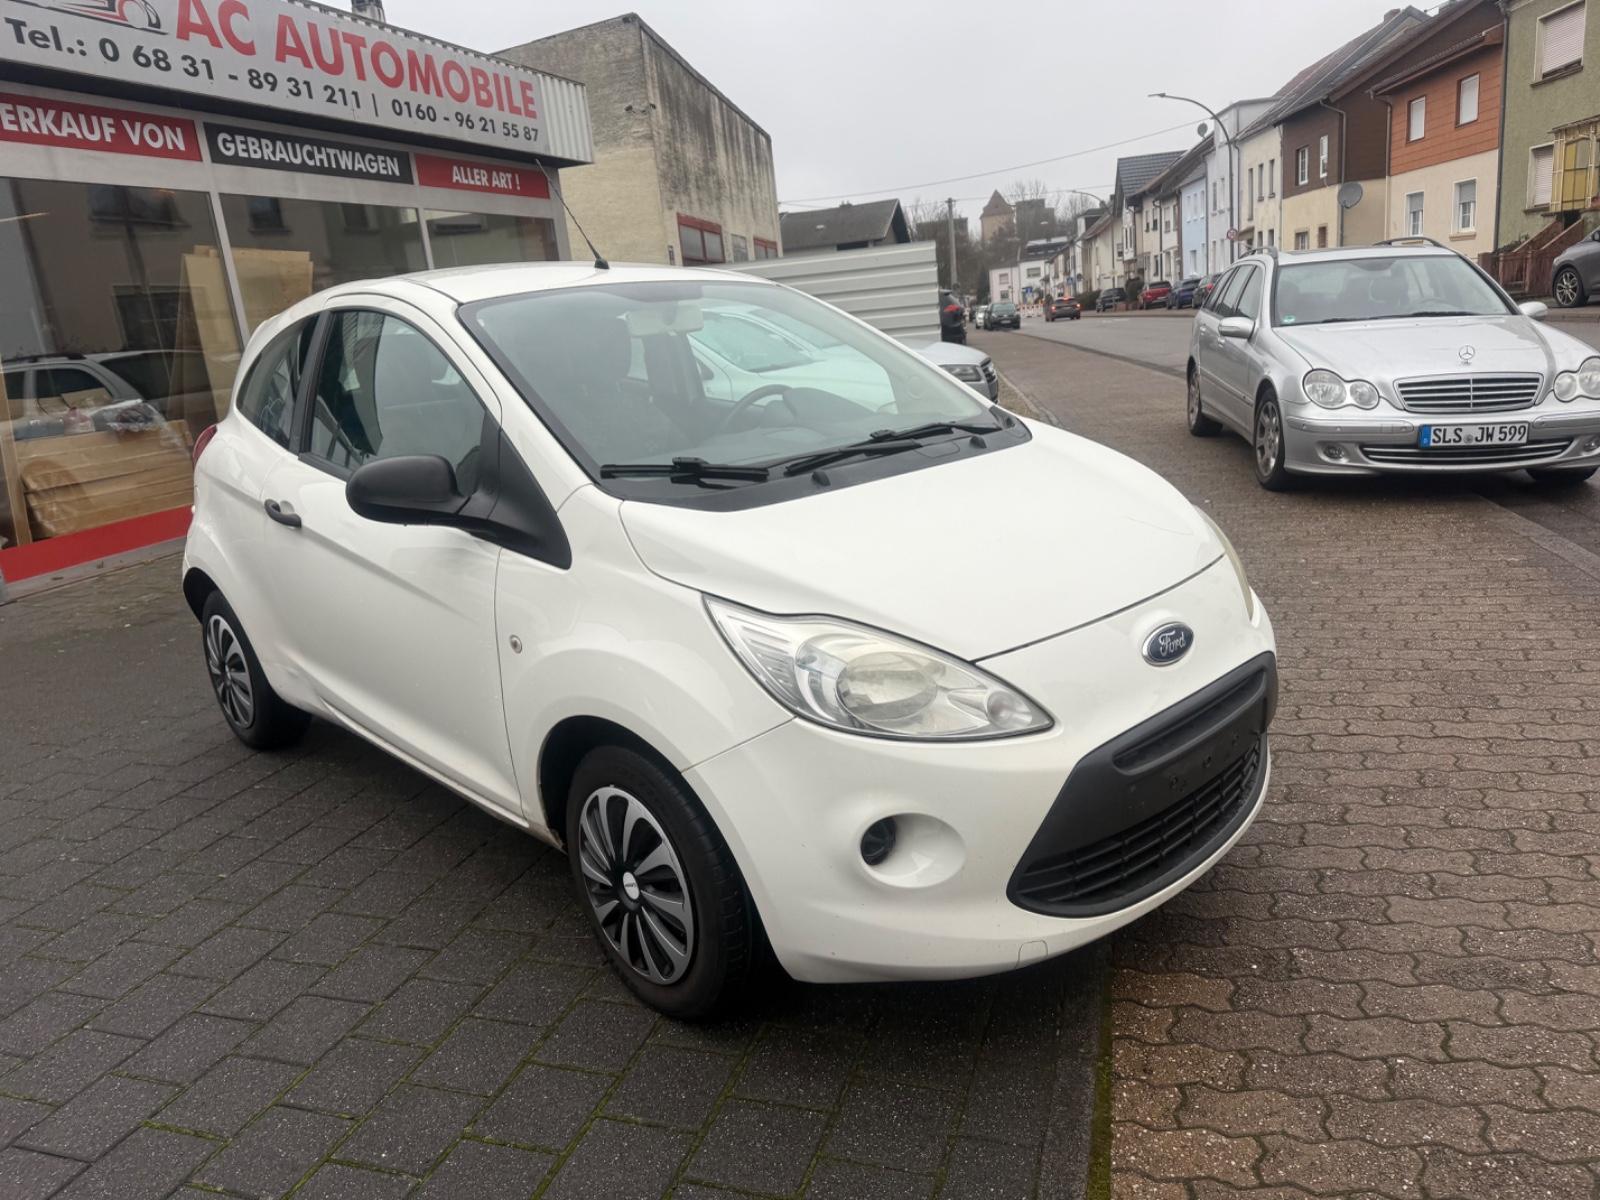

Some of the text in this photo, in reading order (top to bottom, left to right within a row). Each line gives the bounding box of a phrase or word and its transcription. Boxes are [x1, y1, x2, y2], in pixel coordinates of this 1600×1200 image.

[4, 17, 87, 57] Tel.:
[99, 37, 120, 62] 0
[132, 45, 171, 72] 68
[181, 54, 214, 80] 31
[248, 68, 278, 92] 89
[286, 76, 313, 100] 31
[323, 85, 361, 109] 211
[392, 98, 437, 123] 0160
[454, 111, 475, 130] 96
[479, 116, 496, 134] 21
[502, 121, 520, 140] 55
[523, 126, 539, 142] 87
[176, 0, 538, 119] AC AUTOMOBILE
[0, 102, 186, 151] ERKAUF VON
[217, 131, 400, 177] GEBRAUCHTWAGEN
[452, 164, 489, 188] ALLER
[491, 170, 513, 190] ART
[1432, 425, 1527, 444] SLS JW 599
[1158, 629, 1187, 657] Ford
